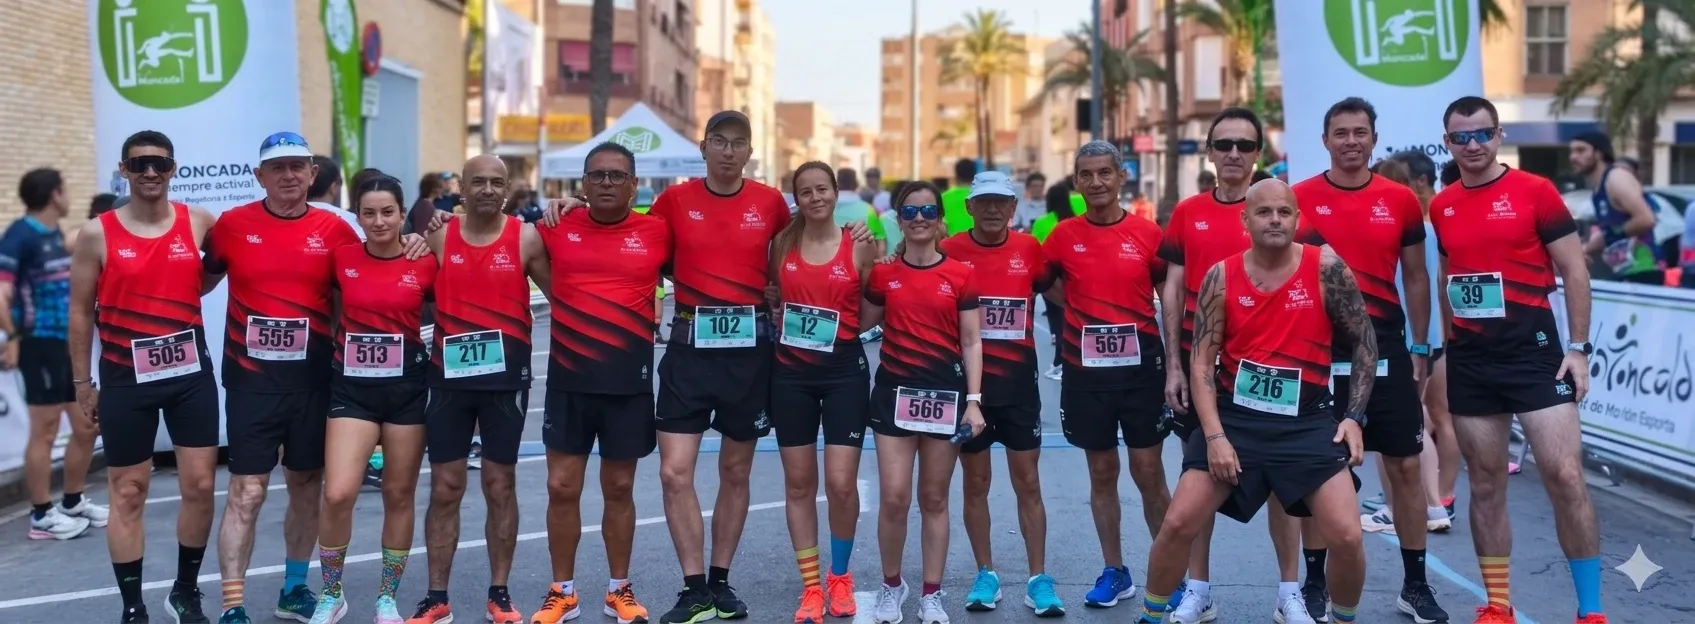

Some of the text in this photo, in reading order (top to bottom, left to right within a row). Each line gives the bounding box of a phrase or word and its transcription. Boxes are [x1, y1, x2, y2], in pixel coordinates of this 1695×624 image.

[173, 163, 252, 178] ONCADA
[1461, 284, 1484, 305] 39
[709, 316, 741, 335] 102
[801, 316, 818, 336] 12
[986, 307, 1015, 326] 574
[258, 327, 295, 348] 555
[1095, 335, 1127, 354] 567
[147, 344, 186, 367] 505
[356, 344, 388, 364] 513
[459, 342, 487, 363] 217
[1248, 374, 1284, 400] 216
[908, 398, 944, 420] 566
